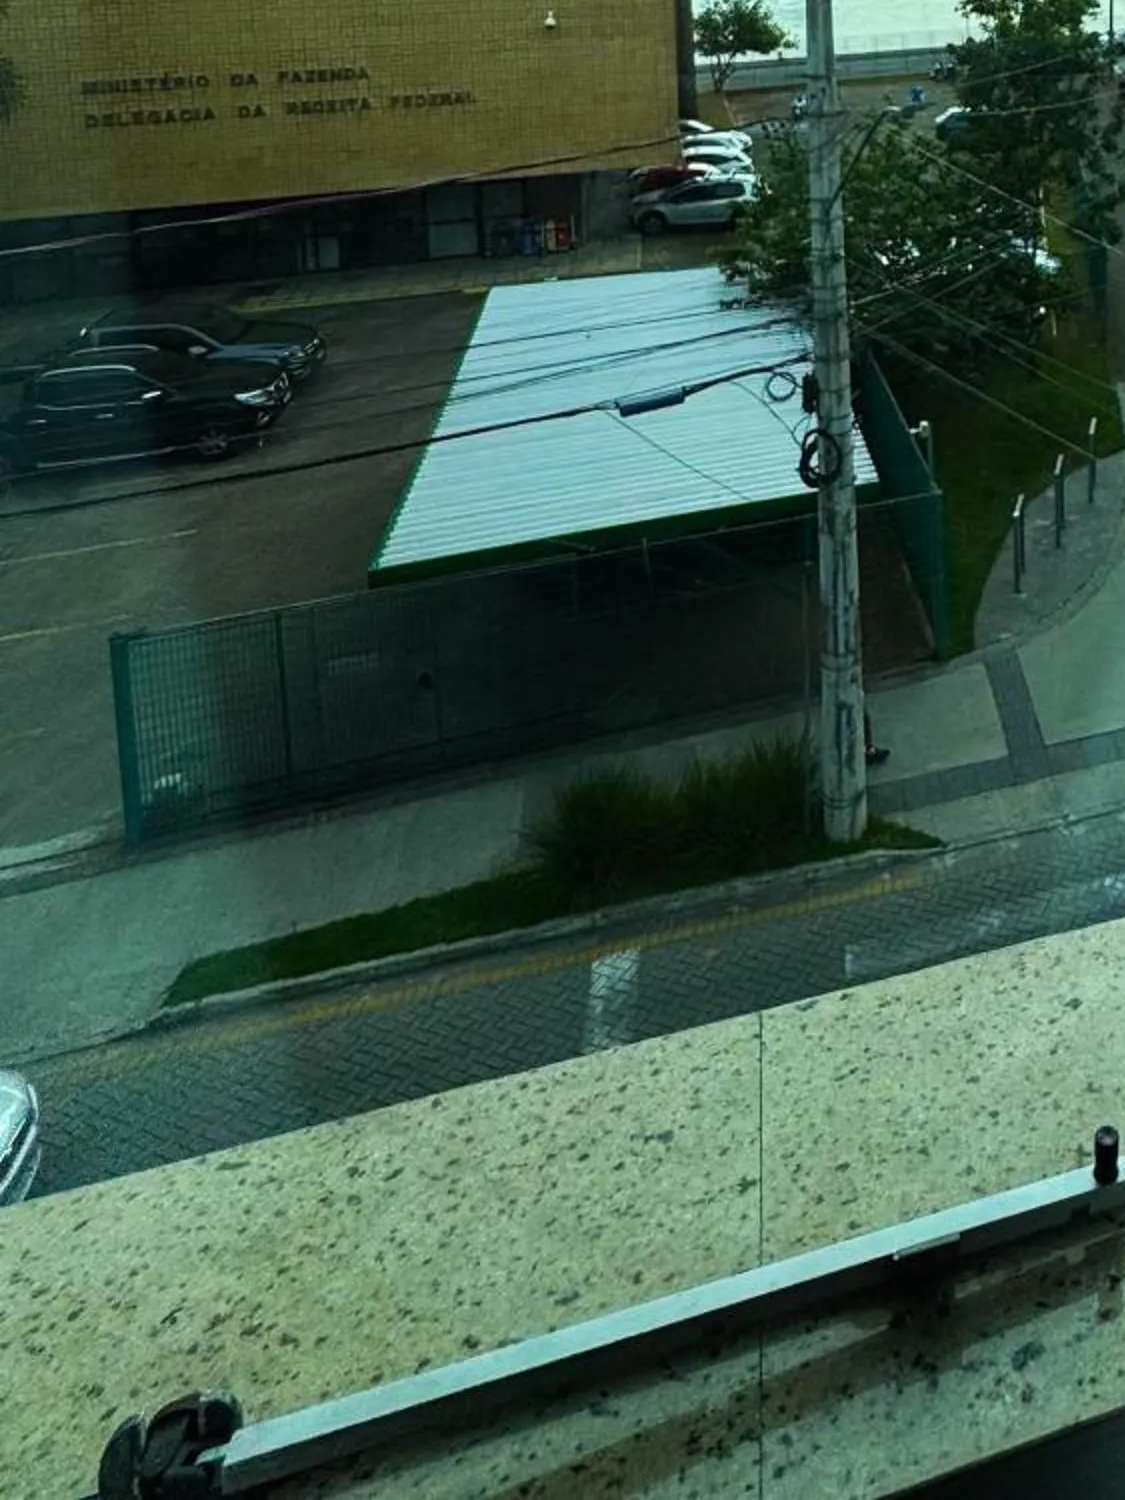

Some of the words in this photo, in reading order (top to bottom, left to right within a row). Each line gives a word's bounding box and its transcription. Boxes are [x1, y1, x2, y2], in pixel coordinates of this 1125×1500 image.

[231, 73, 258, 87] DA
[278, 67, 369, 83] FAZENDA
[85, 108, 215, 128] DELEGACIA
[238, 105, 266, 119] DA
